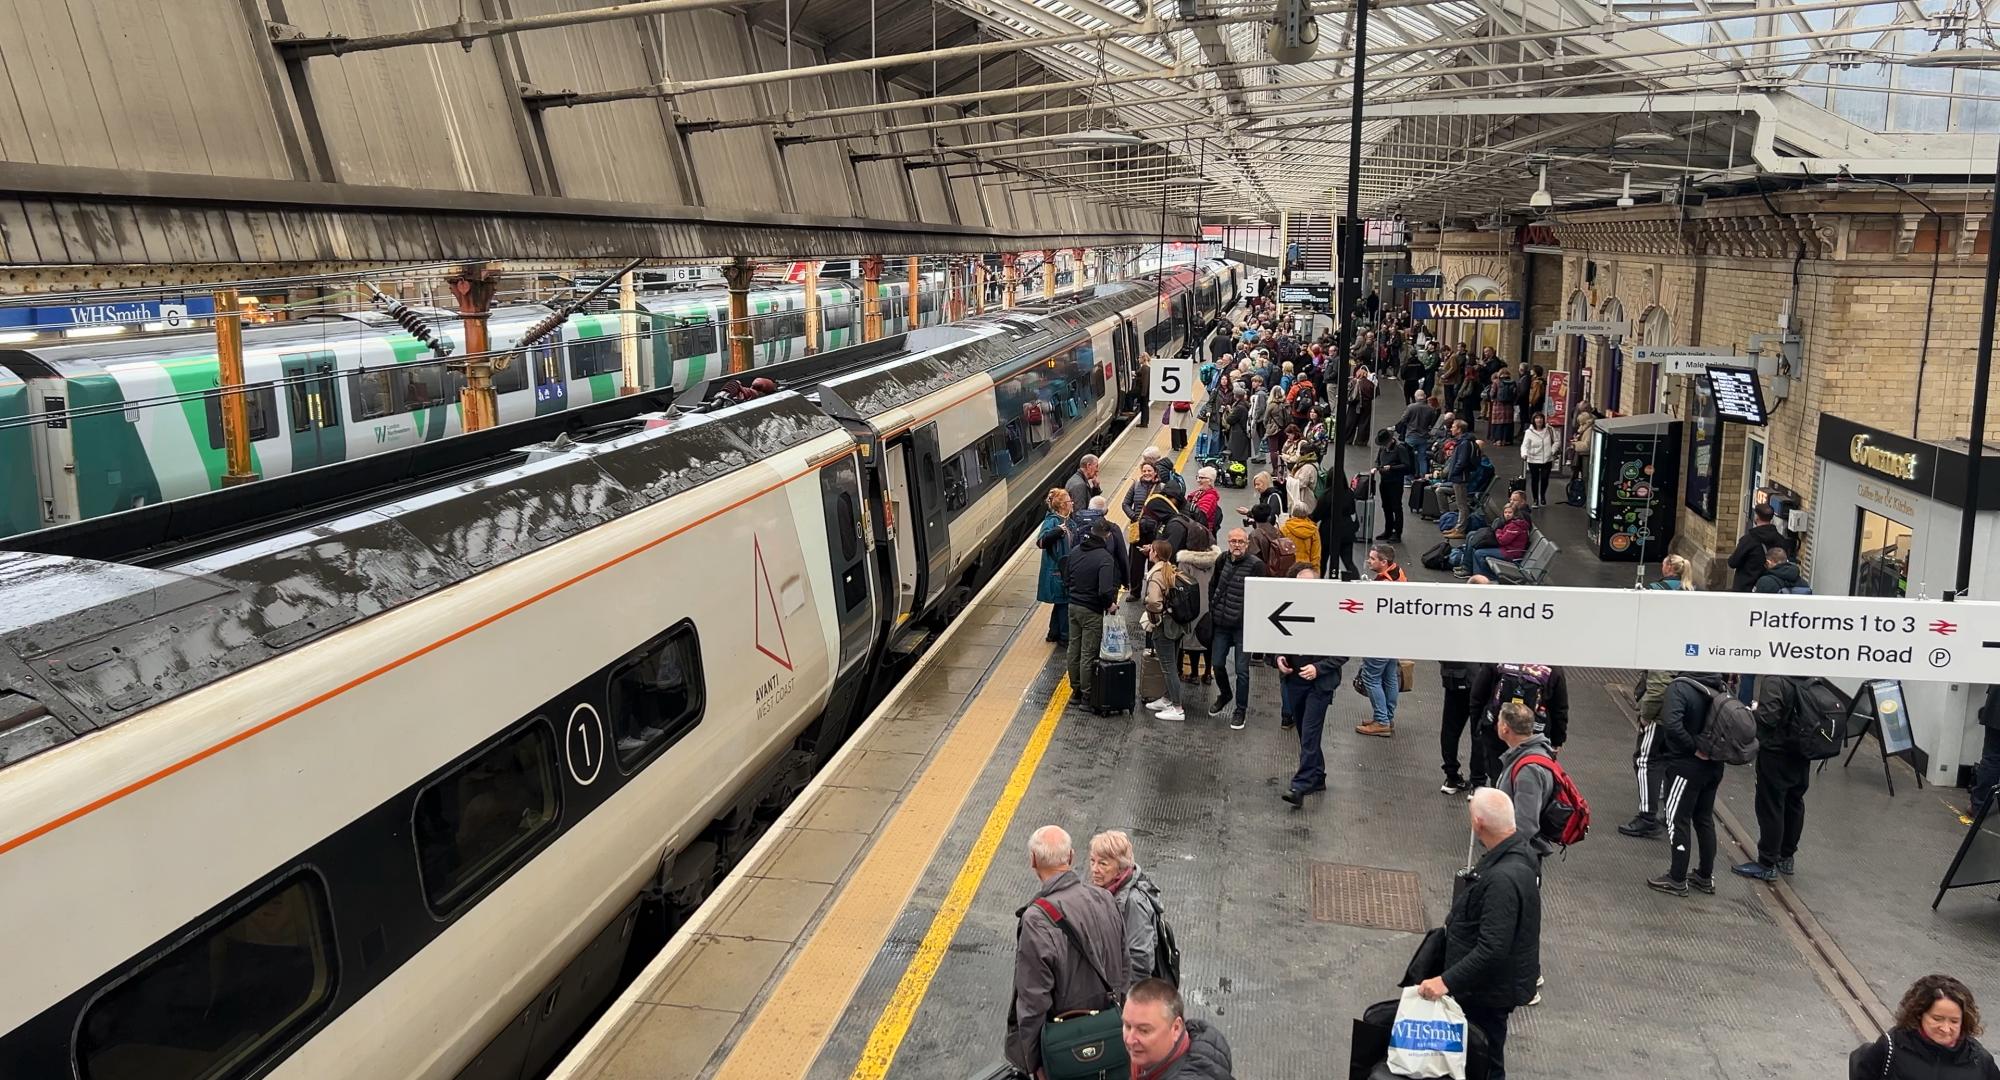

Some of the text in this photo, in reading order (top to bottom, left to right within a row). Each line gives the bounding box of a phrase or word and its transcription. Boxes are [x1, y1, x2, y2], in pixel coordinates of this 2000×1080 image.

[678, 269, 685, 279] 6
[1270, 268, 1276, 276] 5
[1245, 282, 1254, 294] 5
[70, 304, 151, 325] WHSmith
[167, 310, 180, 327] 6
[1428, 303, 1504, 318] WHSmith
[1161, 366, 1181, 394] 5
[1376, 597, 1554, 620] Platforms 4 and 5
[1749, 610, 1916, 633] Platforms 1 to 3
[1708, 641, 1913, 664] via ramp Weston Road
[755, 673, 779, 704] AVANTI
[757, 677, 795, 720] WEST COAST
[578, 722, 591, 767] 1
